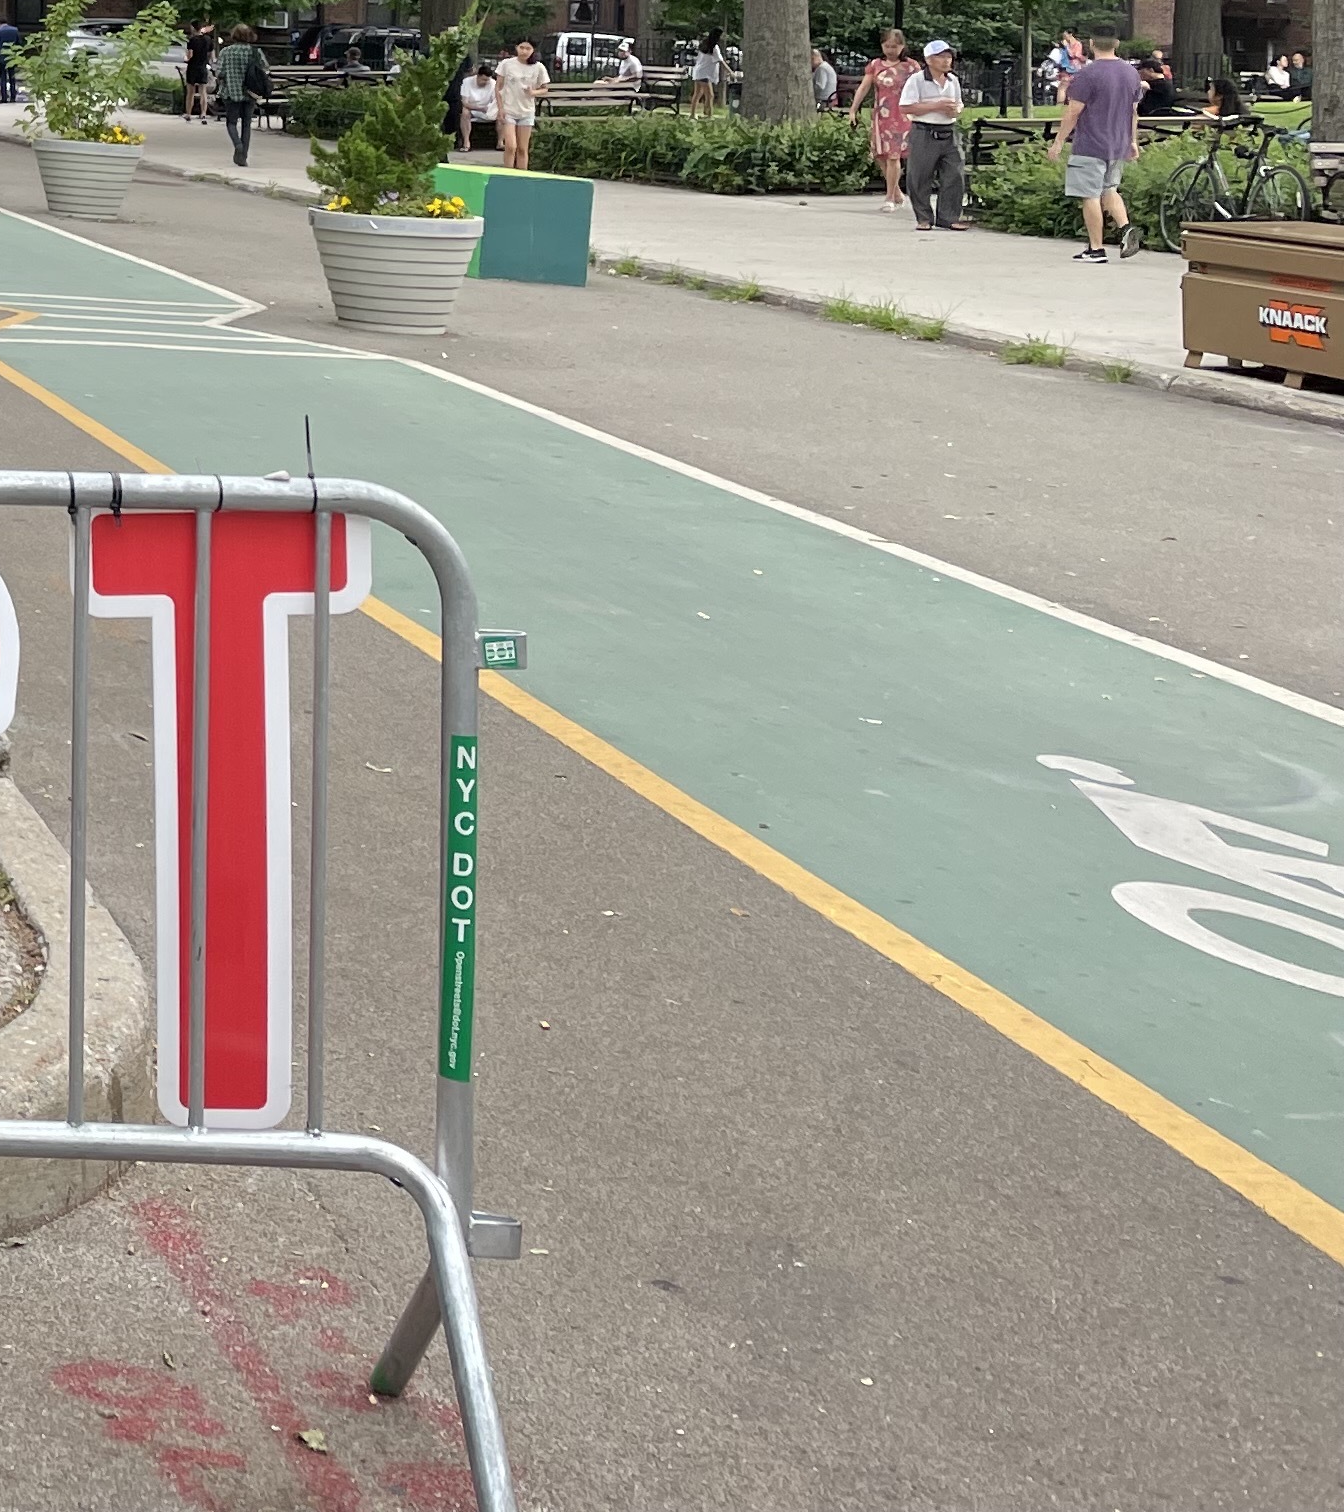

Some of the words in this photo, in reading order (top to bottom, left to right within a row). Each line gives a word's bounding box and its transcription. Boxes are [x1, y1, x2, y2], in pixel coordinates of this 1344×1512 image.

[1258, 305, 1327, 335] KNAACK
[453, 745, 476, 836] NYC
[450, 852, 474, 943] DOT
